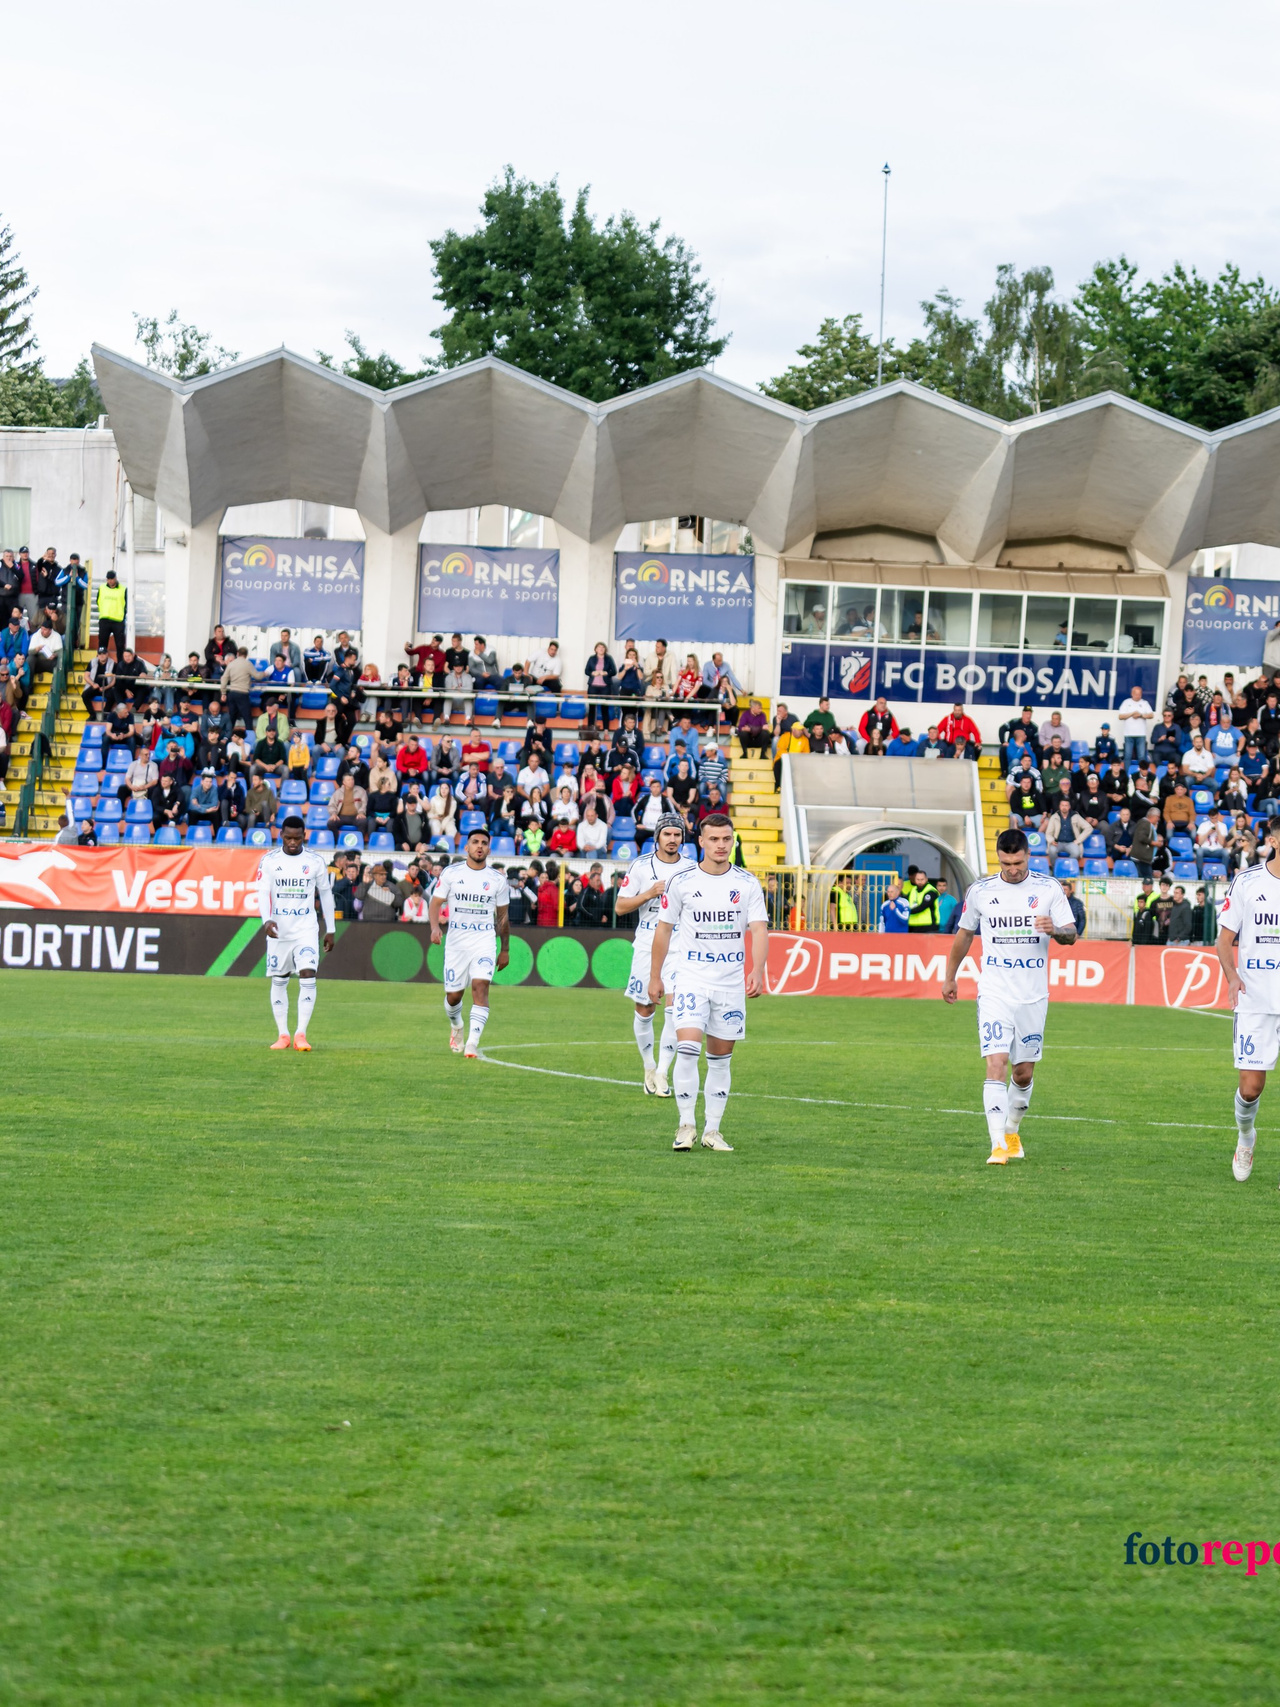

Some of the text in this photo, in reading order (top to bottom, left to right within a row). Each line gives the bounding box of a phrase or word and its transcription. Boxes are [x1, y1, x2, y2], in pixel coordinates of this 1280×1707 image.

[224, 578, 361, 595] aquapark & sports
[422, 586, 557, 602] aquapark & sports
[619, 594, 753, 609] aquapark & sports
[1185, 618, 1254, 631] aquapark
[1259, 620, 1269, 631] &
[884, 661, 1118, 701] FC BOTOȘANI
[25, 721, 31, 731] 7
[68, 723, 73, 733] 7
[749, 795, 755, 804] 5
[752, 819, 758, 828] 4
[111, 869, 260, 910] Vestra
[275, 878, 312, 887] UNIBET
[454, 892, 493, 904] UNIBET
[693, 910, 741, 922] UNIBET
[449, 921, 494, 932] ELSACO
[0, 922, 161, 971] ORTIVE
[687, 950, 744, 963] ELSACO
[986, 955, 1045, 969] ELSACO
[1049, 959, 1105, 987] HD
[629, 975, 643, 994] 20
[676, 992, 696, 1012] 33
[983, 1020, 1003, 1042] 30
[1239, 1034, 1255, 1056] 16
